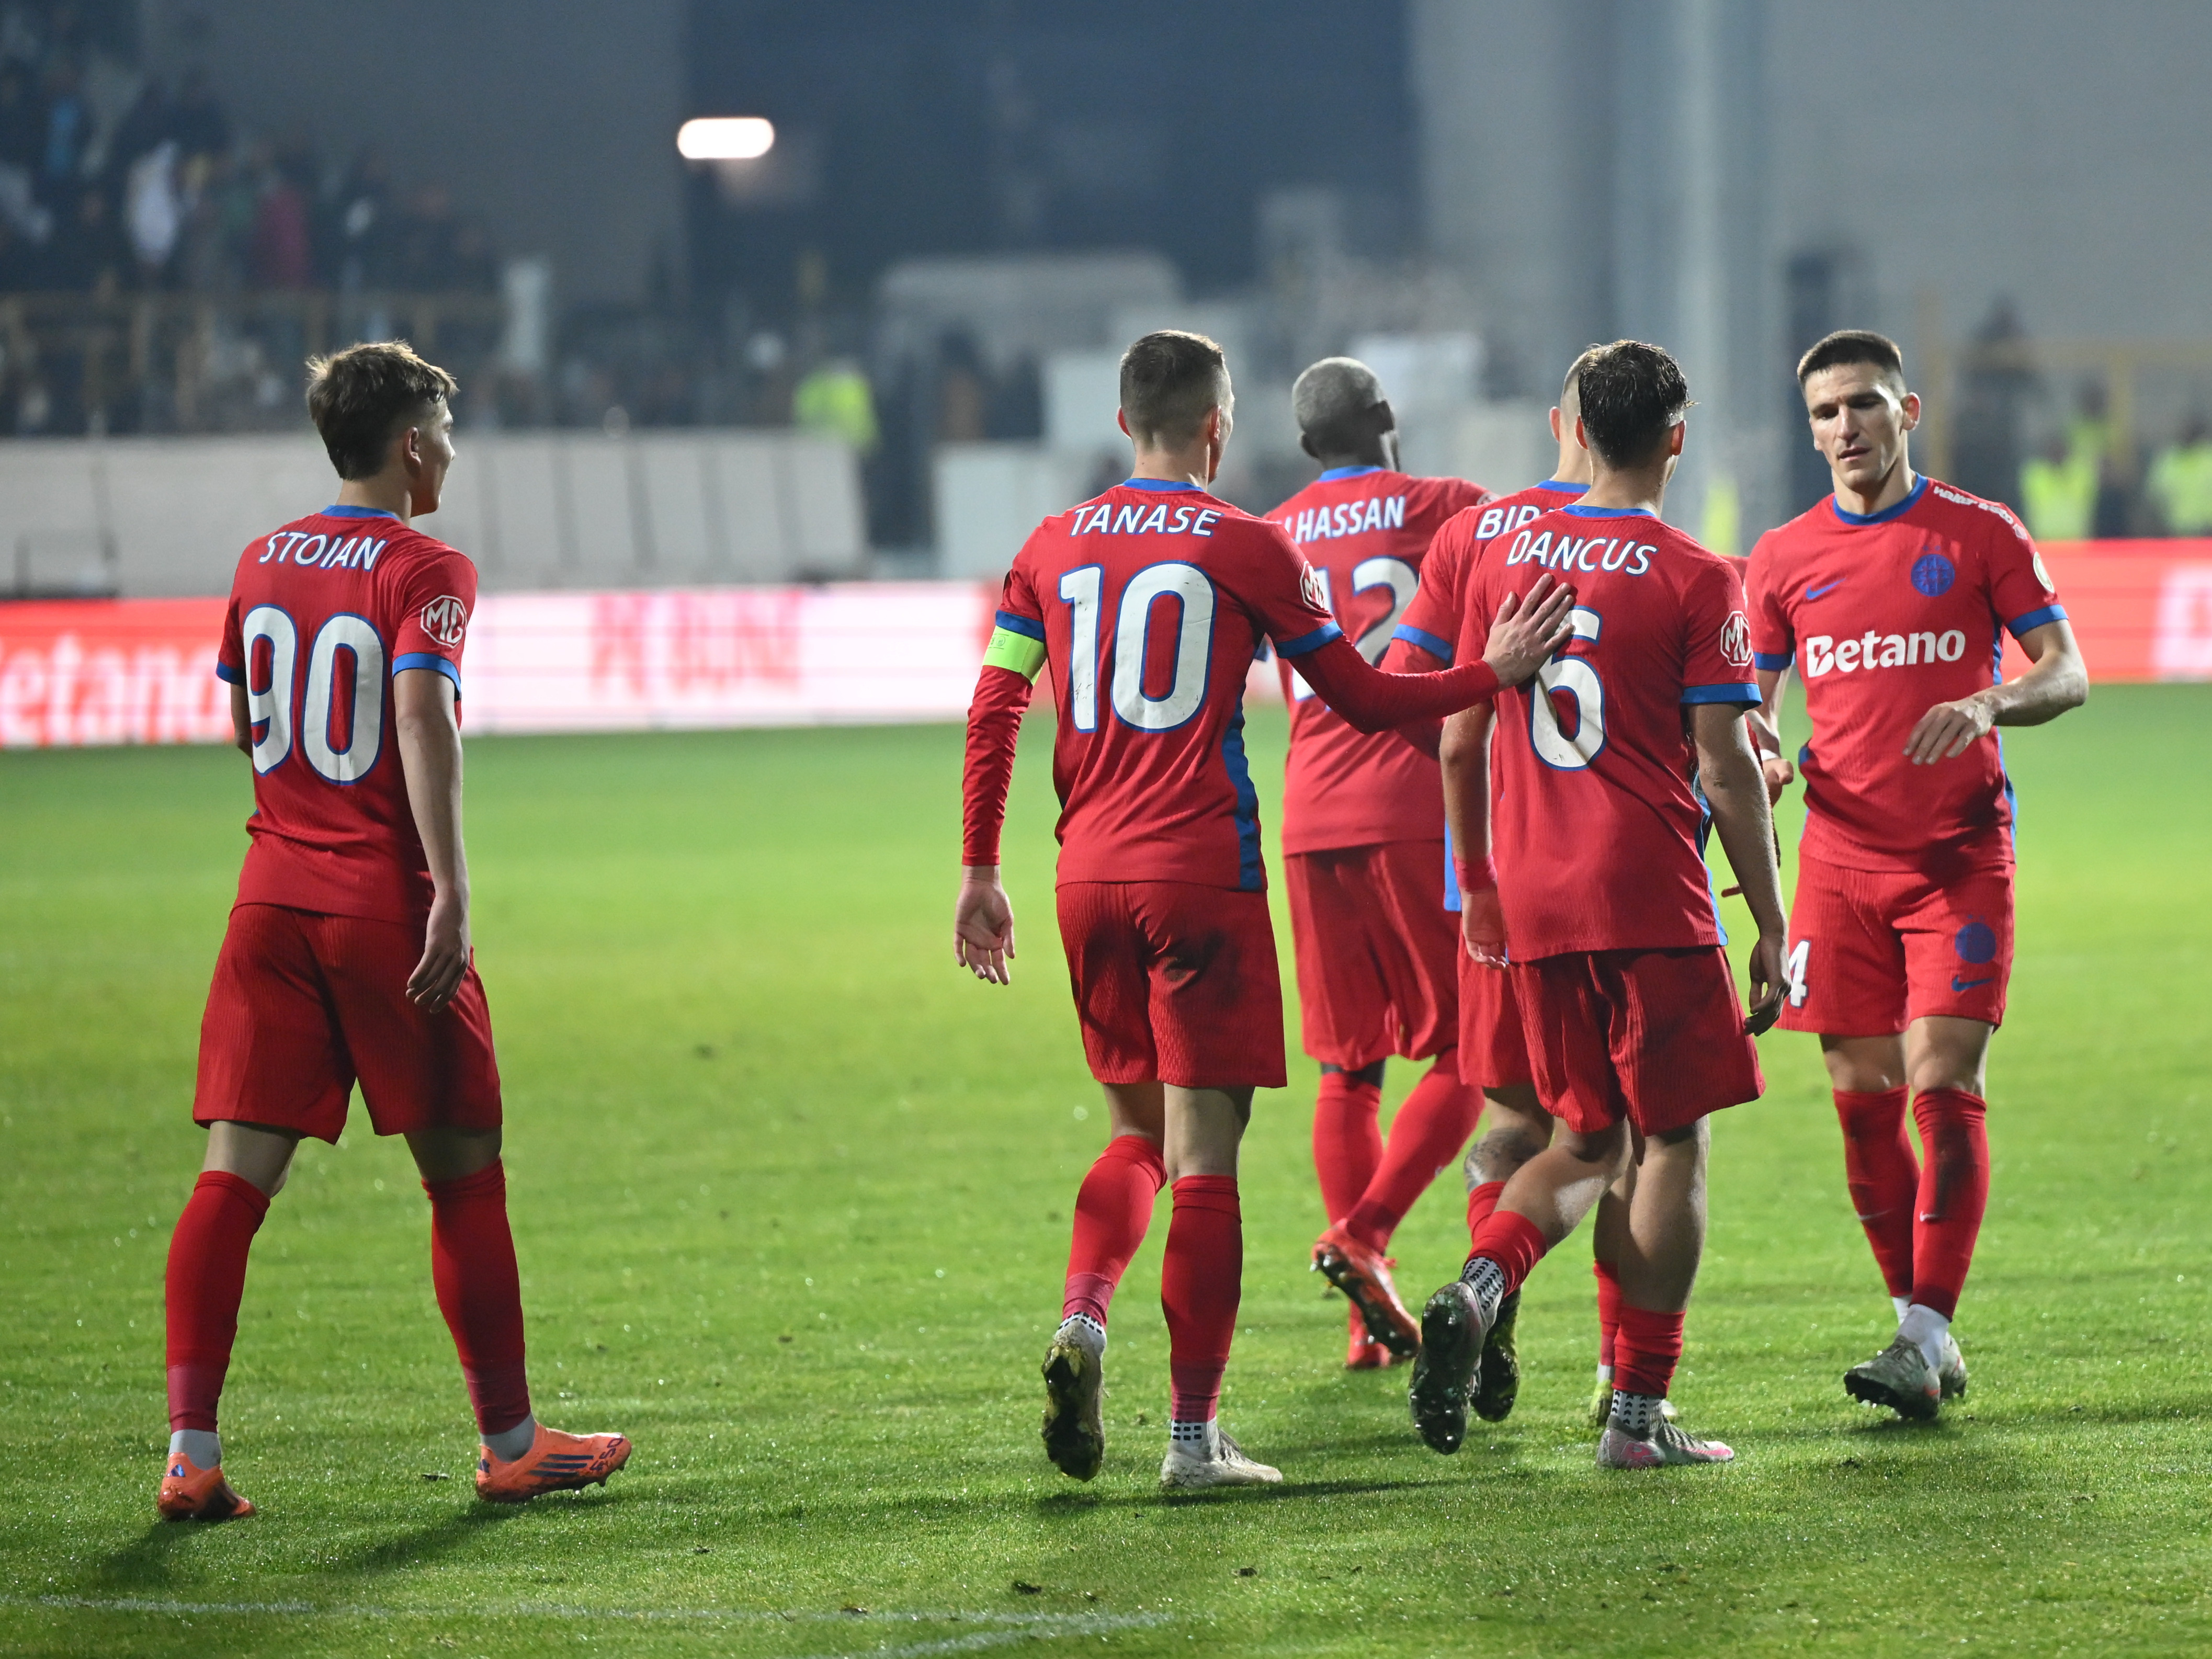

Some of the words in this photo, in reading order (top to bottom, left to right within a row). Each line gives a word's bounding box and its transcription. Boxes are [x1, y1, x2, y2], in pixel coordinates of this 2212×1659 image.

[1071, 504, 1222, 537] TANASE
[258, 531, 386, 572] STOIAN
[1506, 530, 1658, 576] DANCUS
[426, 598, 465, 644] MG
[1058, 560, 1217, 733] 10
[1806, 630, 1966, 679] Betano
[243, 603, 386, 786] 90
[1529, 605, 1607, 771] 6
